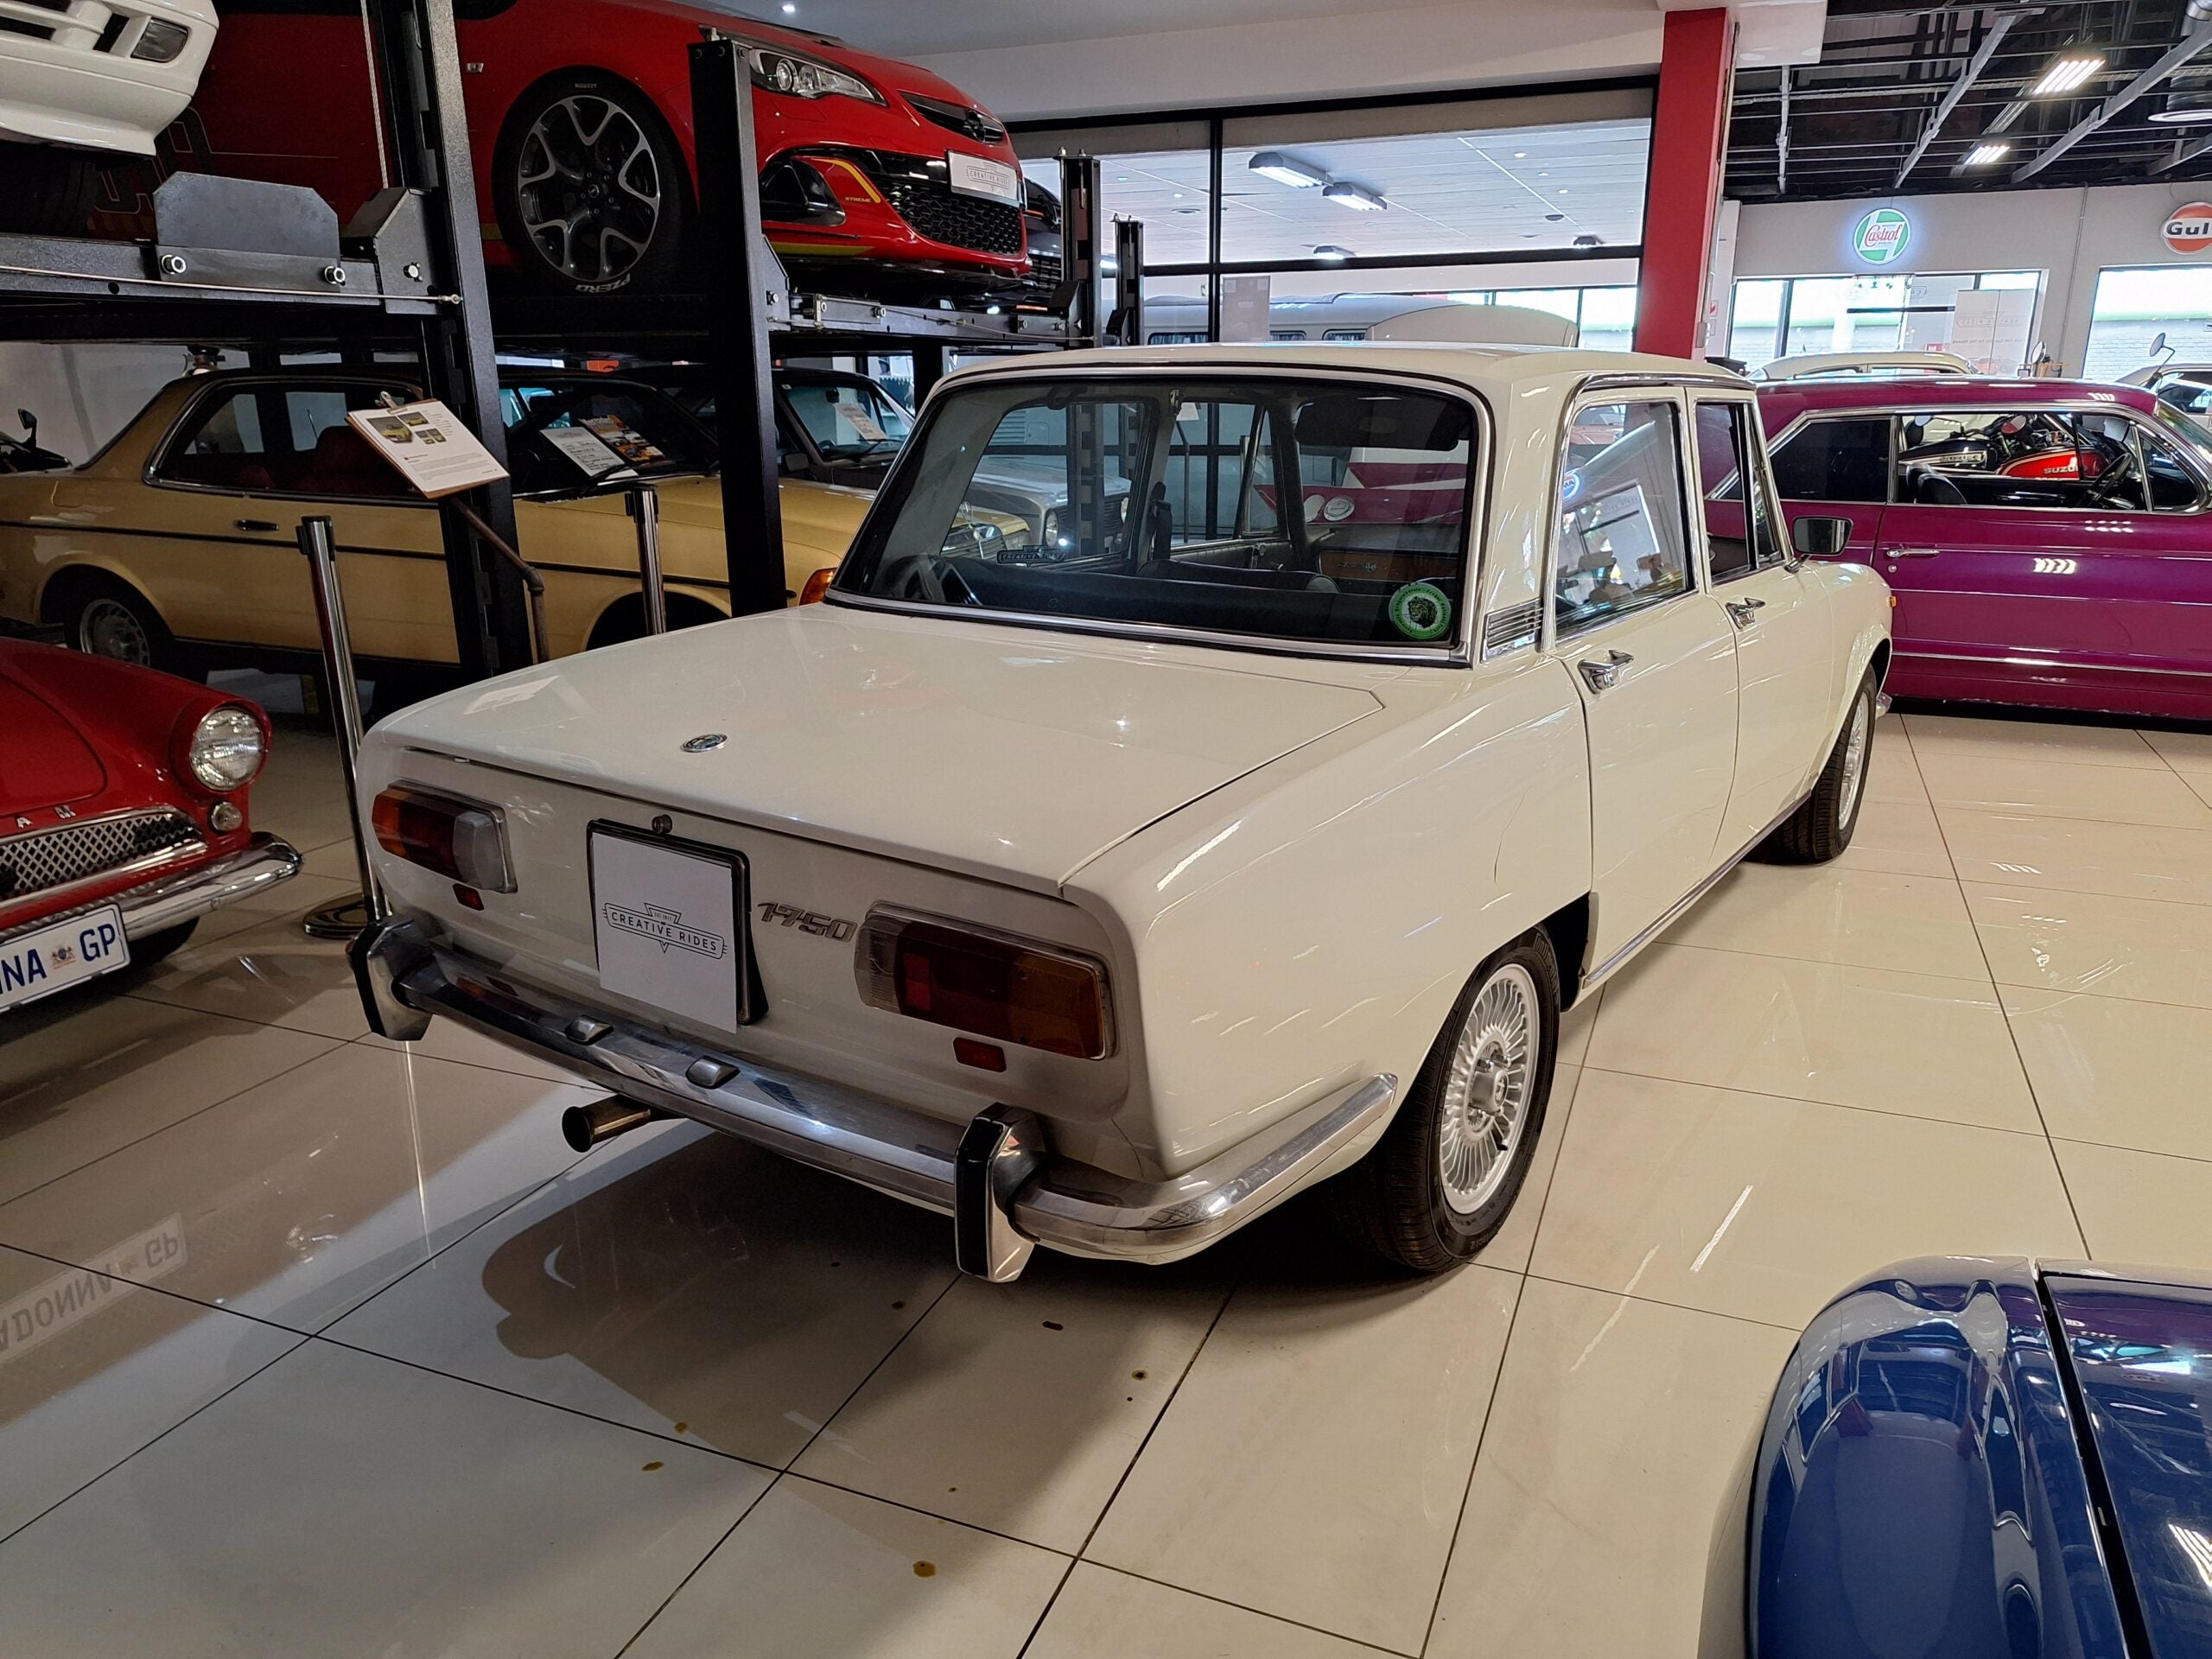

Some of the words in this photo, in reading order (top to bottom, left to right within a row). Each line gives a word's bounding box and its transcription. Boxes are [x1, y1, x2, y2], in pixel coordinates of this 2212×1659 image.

[1864, 224, 1904, 247] Castrol
[2044, 466, 2079, 474] SUZU
[611, 912, 672, 938] CREATIVE
[679, 931, 716, 951] RIDES
[757, 903, 858, 943] 1750
[0, 949, 47, 994] NA
[79, 923, 116, 962] GP
